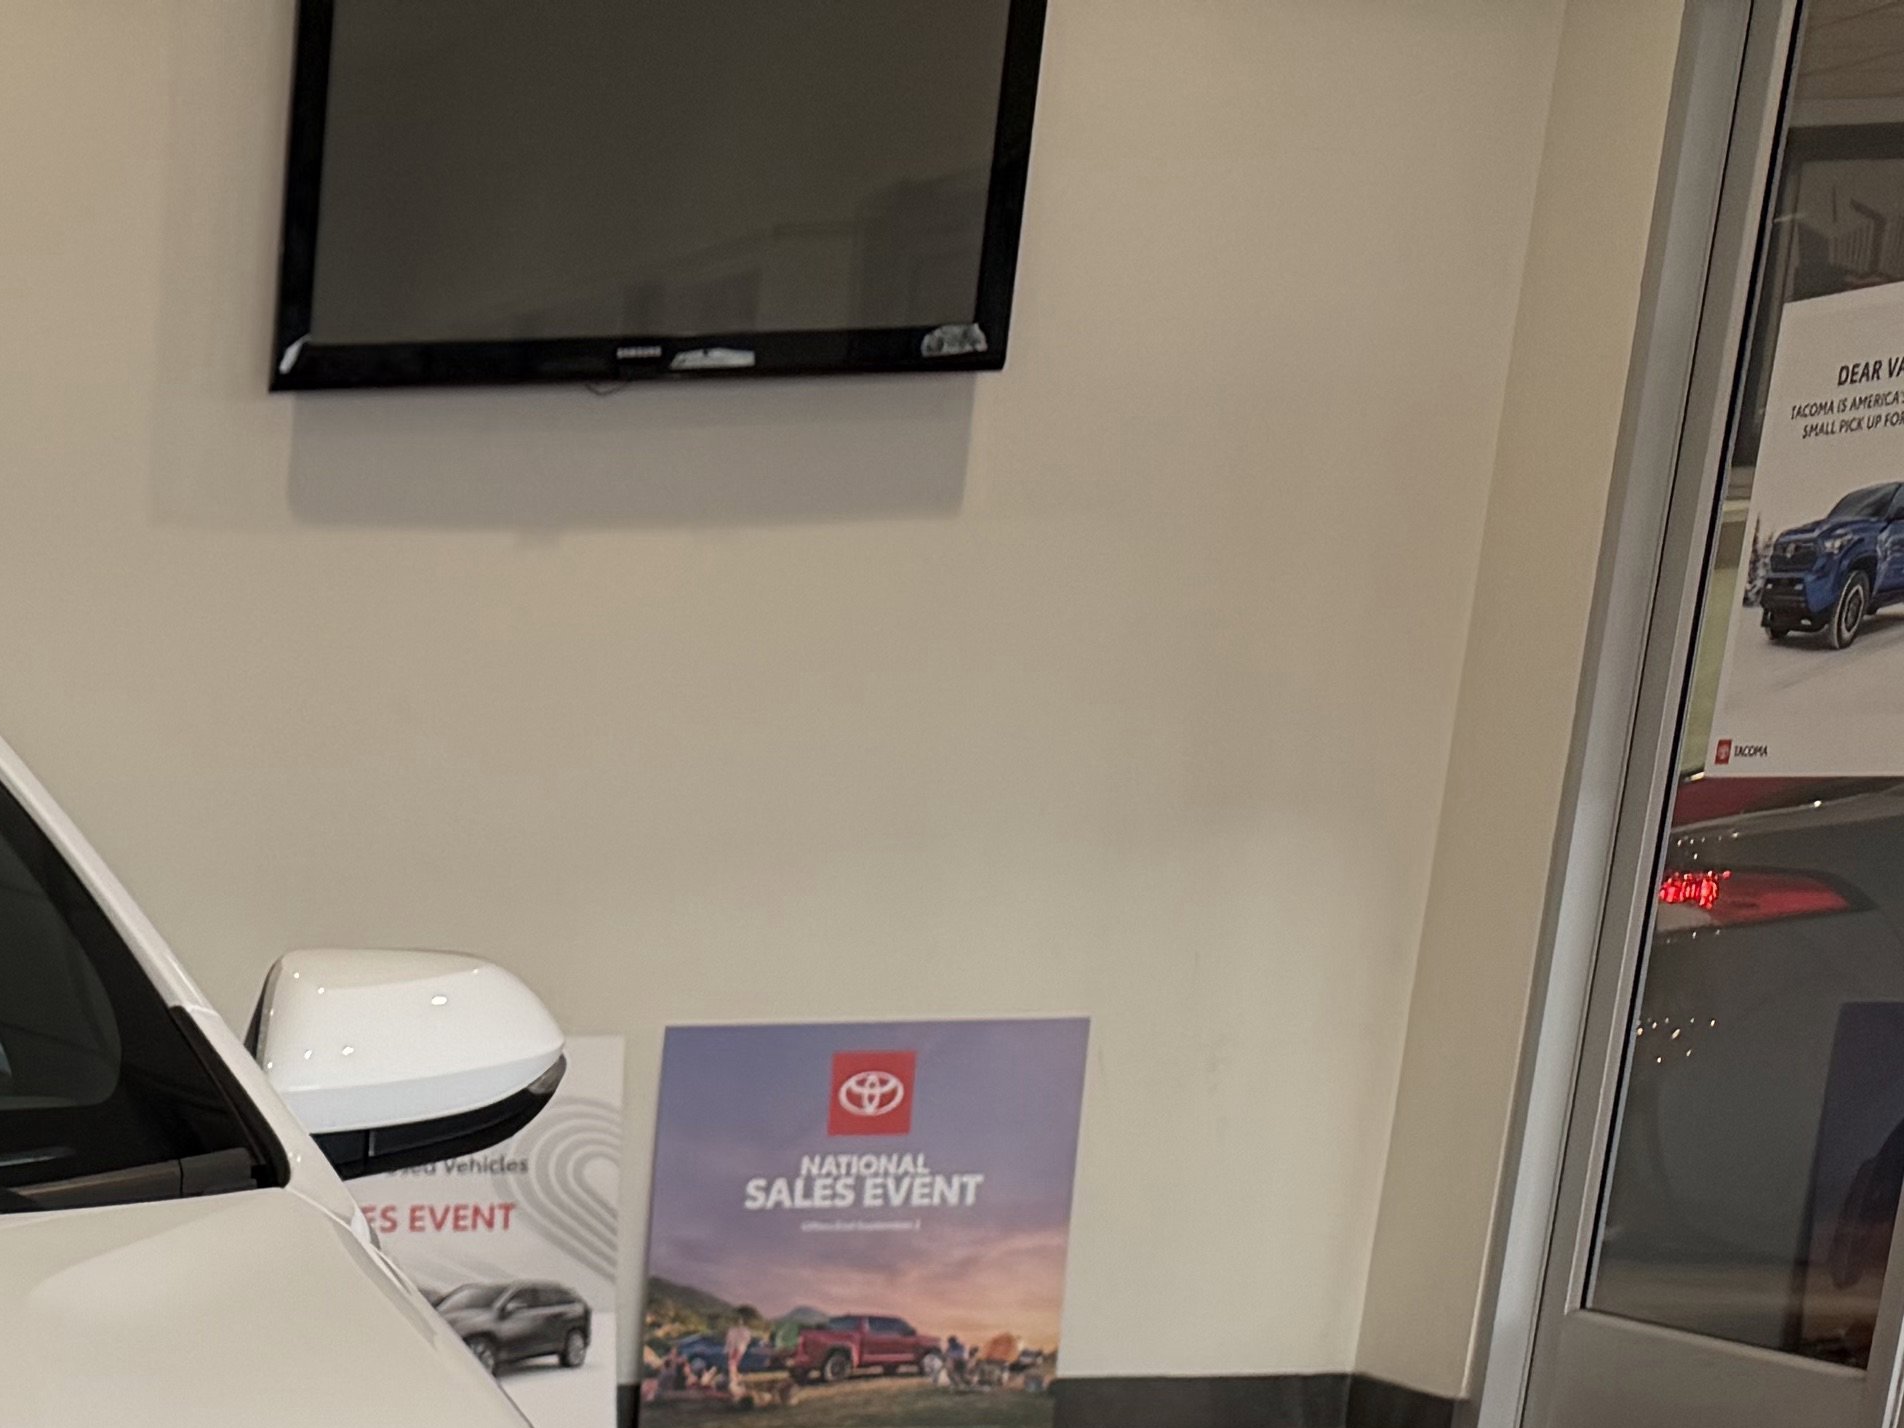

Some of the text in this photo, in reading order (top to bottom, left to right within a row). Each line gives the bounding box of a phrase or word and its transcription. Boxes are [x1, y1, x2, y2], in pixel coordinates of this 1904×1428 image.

[1837, 360, 1882, 386] DEAR
[1791, 400, 1834, 420] TACOMA
[1837, 397, 1847, 413] IS
[1802, 420, 1836, 439] SMALL
[1839, 416, 1864, 433] PICK
[1866, 414, 1882, 429] UP
[443, 1155, 529, 1176] Vehicles
[800, 1153, 930, 1177] NATIONAL
[744, 1174, 984, 1210] SALES EVENT
[409, 1203, 517, 1232] EVENT
